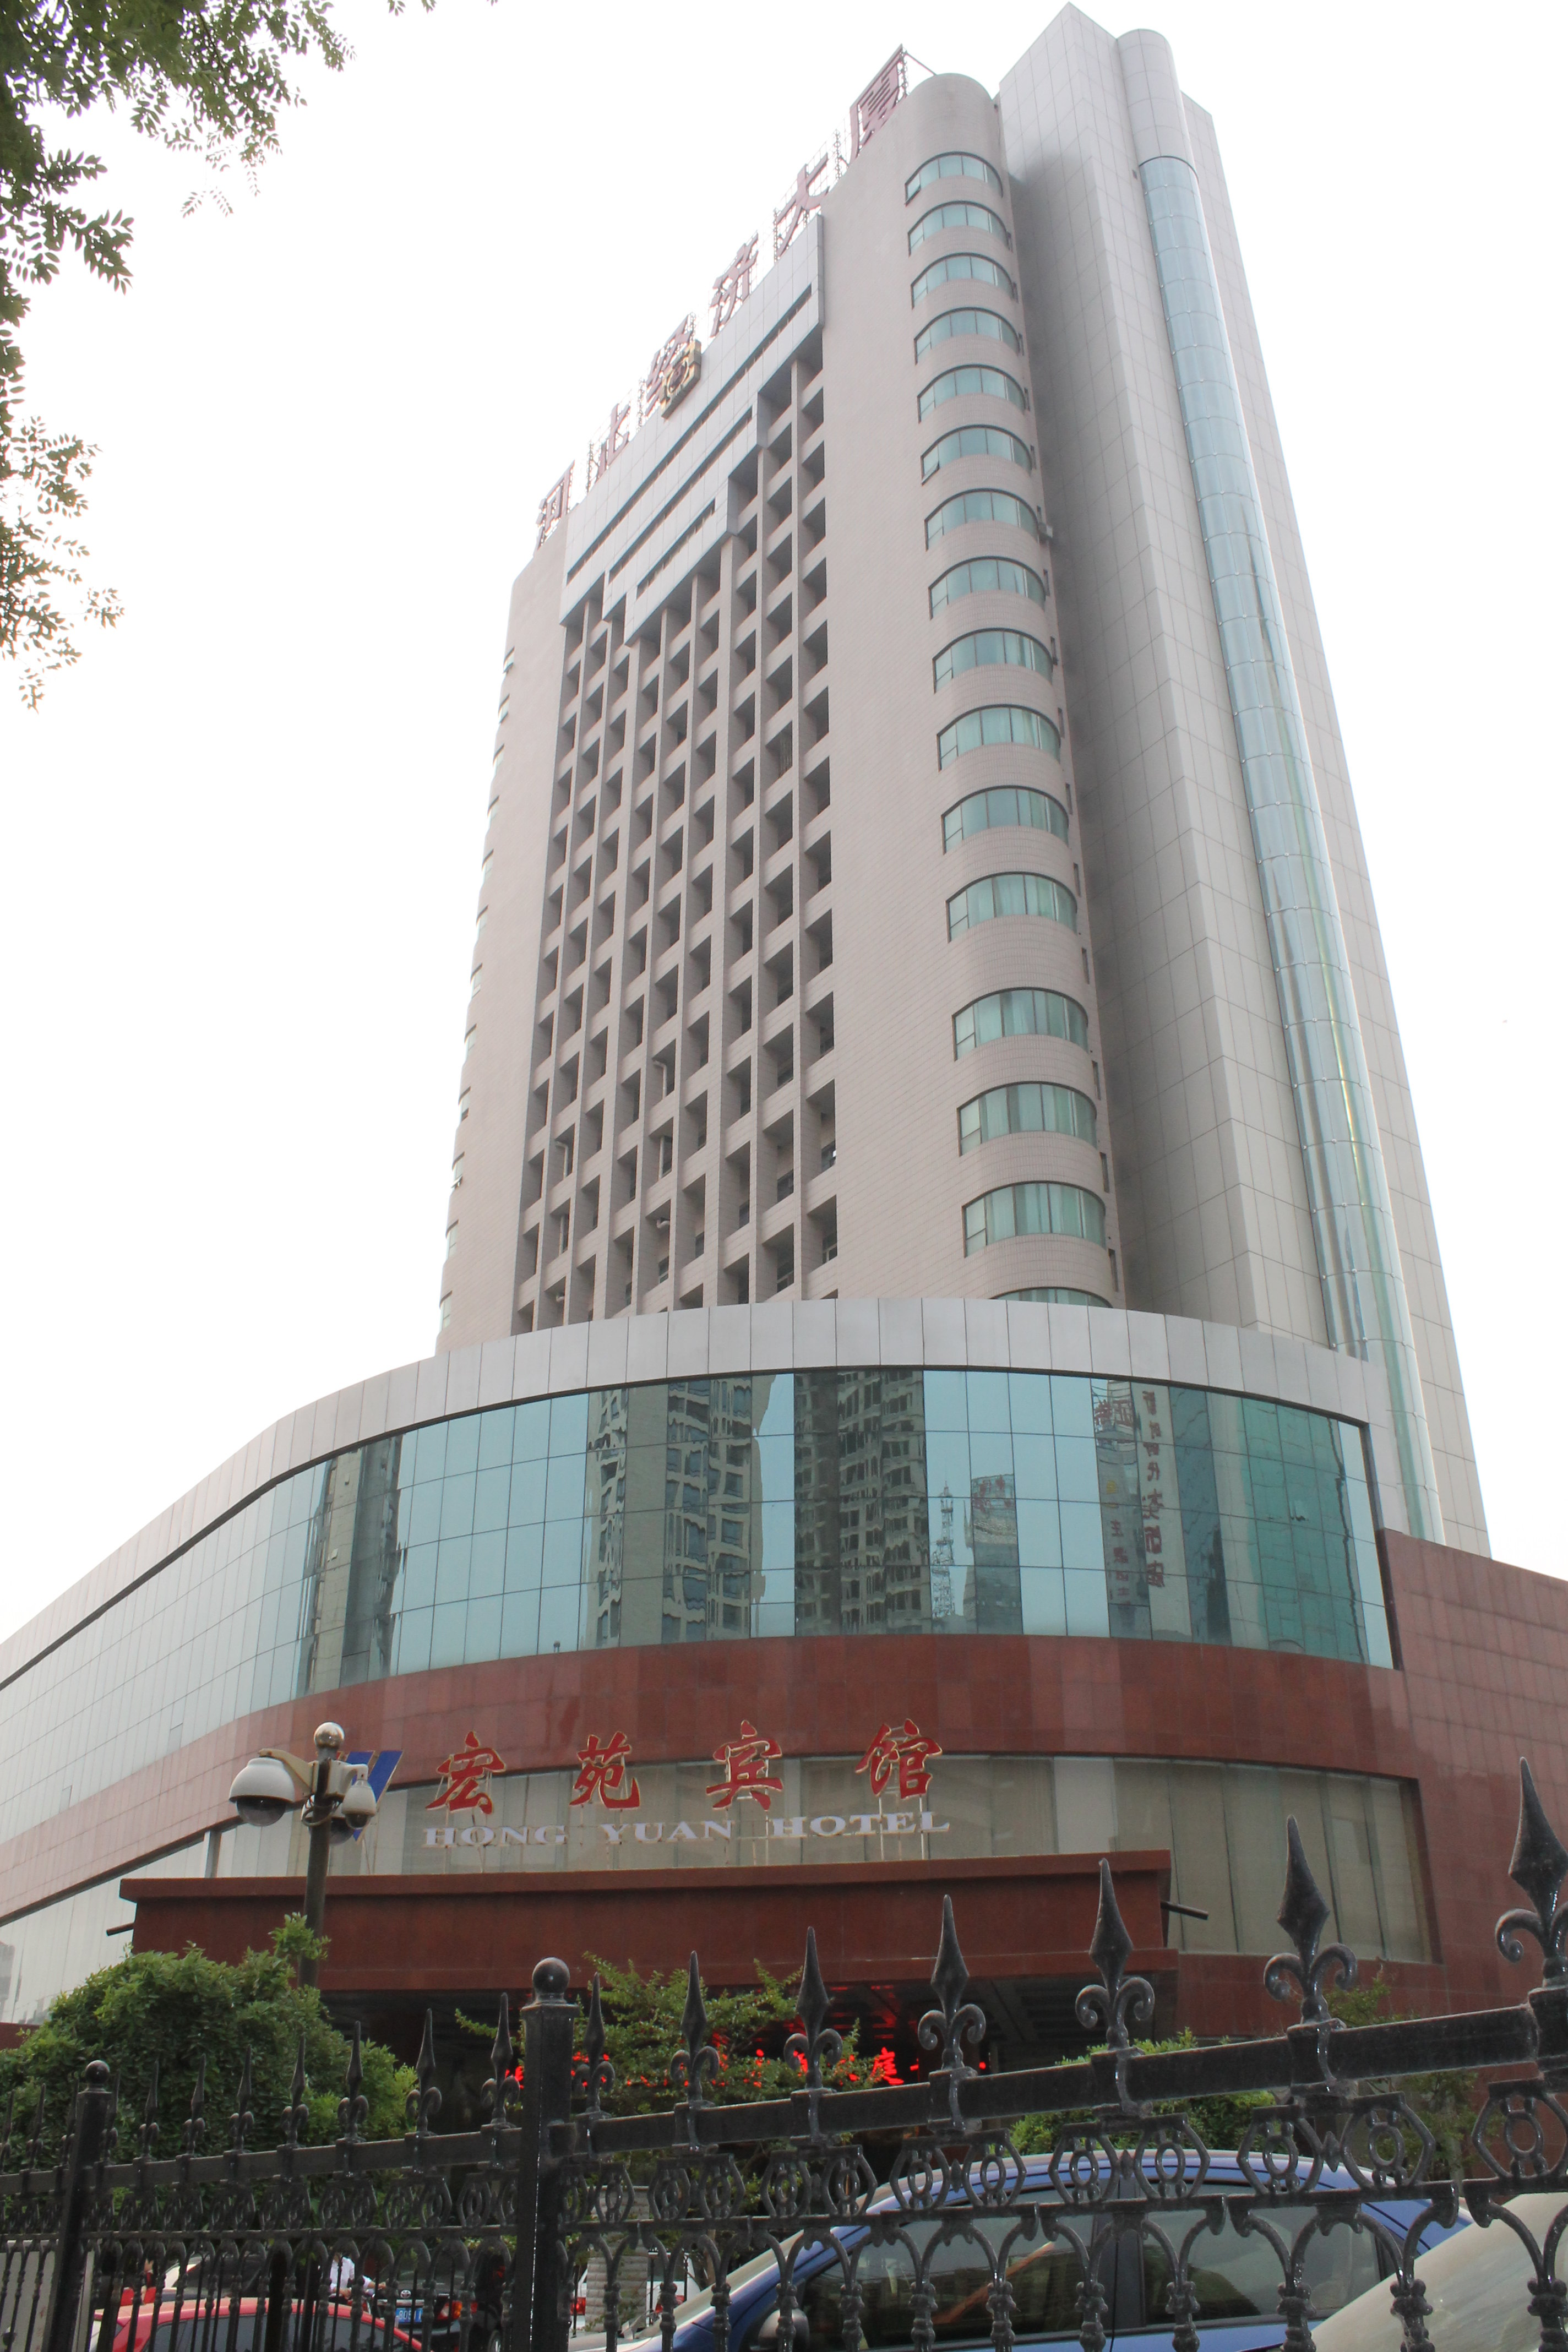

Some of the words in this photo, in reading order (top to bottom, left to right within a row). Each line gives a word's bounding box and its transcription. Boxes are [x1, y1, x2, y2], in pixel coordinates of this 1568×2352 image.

[534, 44, 906, 552] 河北经济大厦
[426, 1718, 943, 1815] 宏苑宾馆
[423, 1825, 567, 1847] HONG
[600, 1821, 733, 1843] YUAN
[772, 1810, 950, 1837] HOTEL
